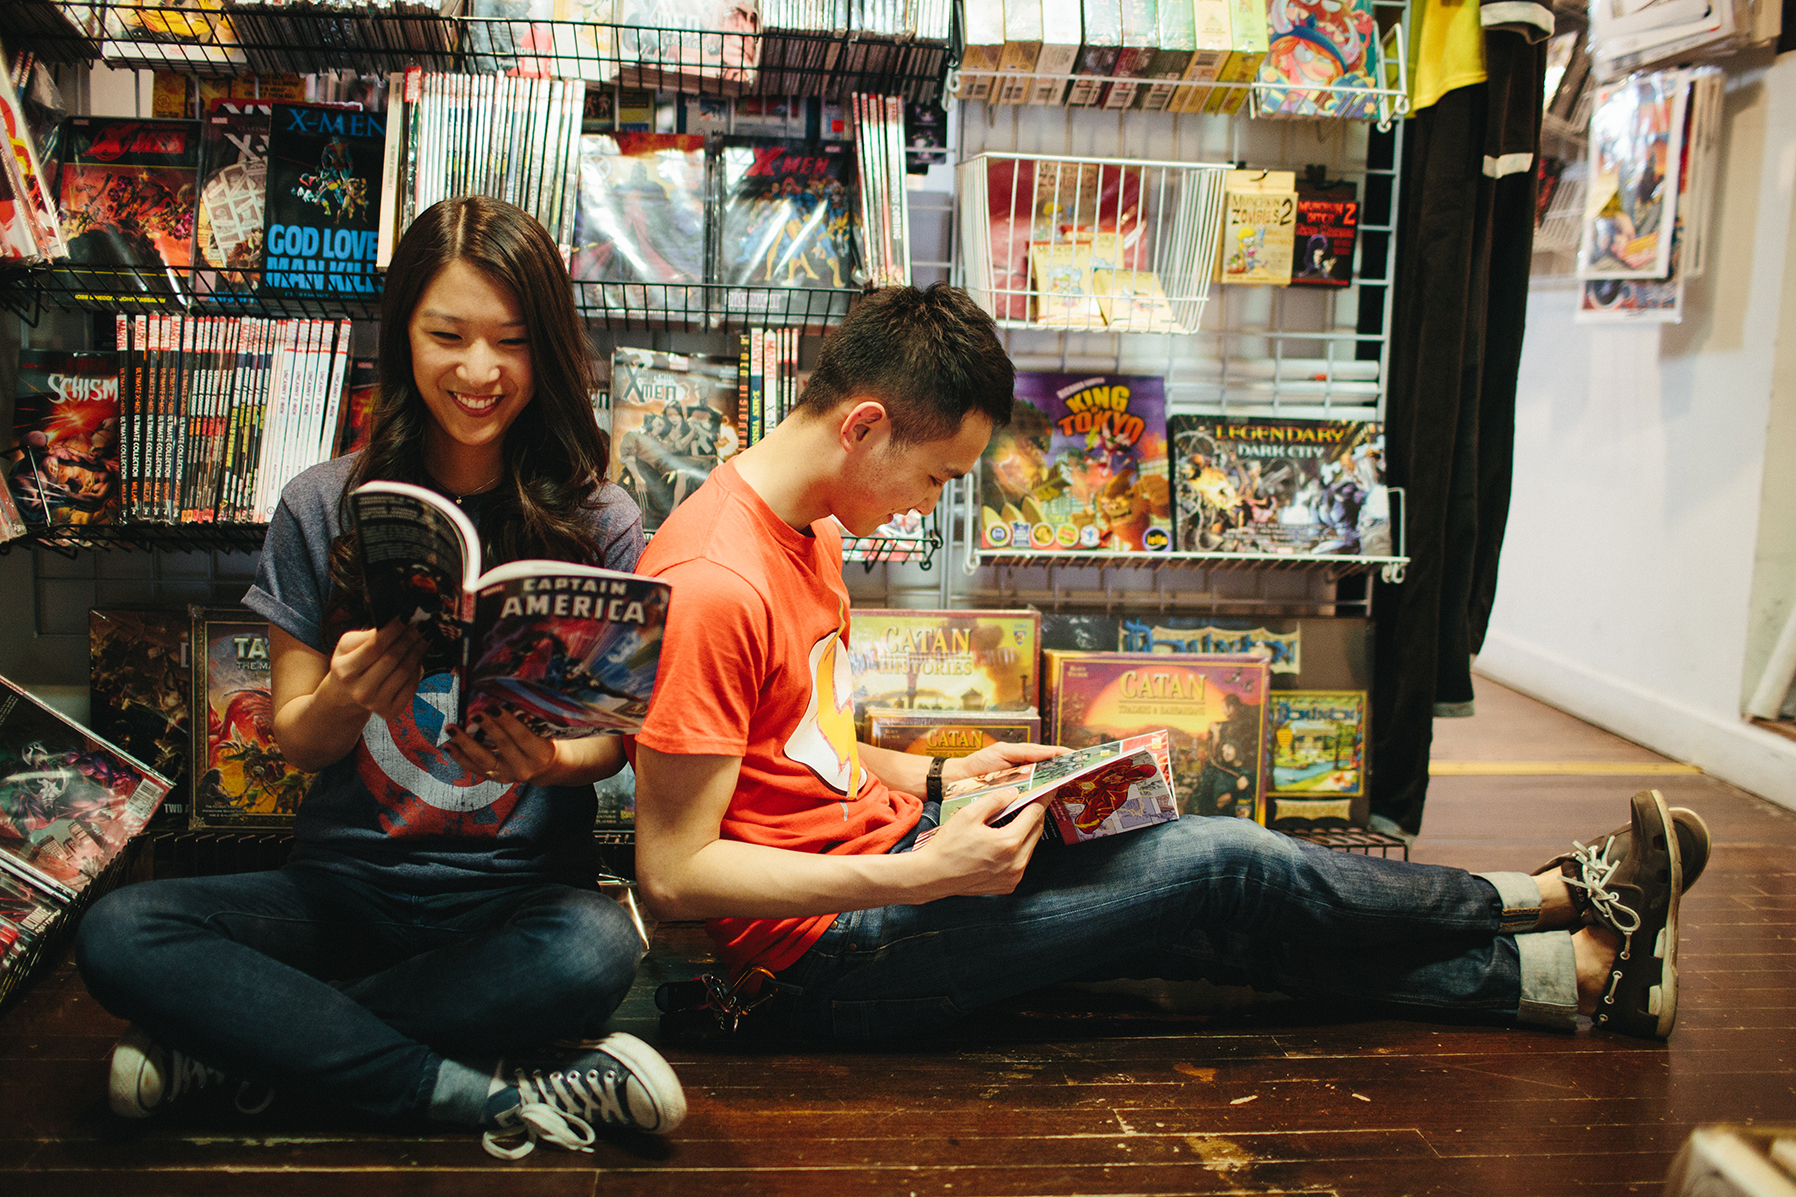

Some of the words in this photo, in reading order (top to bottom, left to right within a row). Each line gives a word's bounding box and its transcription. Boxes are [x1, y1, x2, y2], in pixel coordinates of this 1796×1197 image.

[287, 108, 387, 137] X-MEN
[744, 147, 830, 176] X-MEN
[528, 188, 537, 216] COMPLE
[1232, 209, 1279, 225] ZOMBIES
[1280, 198, 1292, 225] 2
[1343, 203, 1357, 225] 2
[268, 224, 319, 256] GOD
[322, 228, 379, 260] LOVE
[266, 256, 325, 291] MAN
[328, 261, 385, 293] KILL
[752, 334, 762, 374] MARVEL
[766, 340, 774, 382] MARVEL
[48, 374, 118, 404] SCHISM
[1066, 385, 1130, 414] KING
[1058, 410, 1145, 443] TOKYO
[1216, 424, 1345, 443] LEGENDARY
[1238, 444, 1285, 457] DARK
[1287, 445, 1325, 458] CITY
[523, 578, 627, 595] CAPTAIN
[501, 594, 645, 624] AMERICA
[882, 626, 972, 654] CATAN
[237, 662, 256, 670] THE
[880, 661, 972, 675] HISTORIES
[1119, 670, 1206, 700] CATAN
[926, 729, 984, 748] CATAN
[164, 804, 182, 813] TWO
